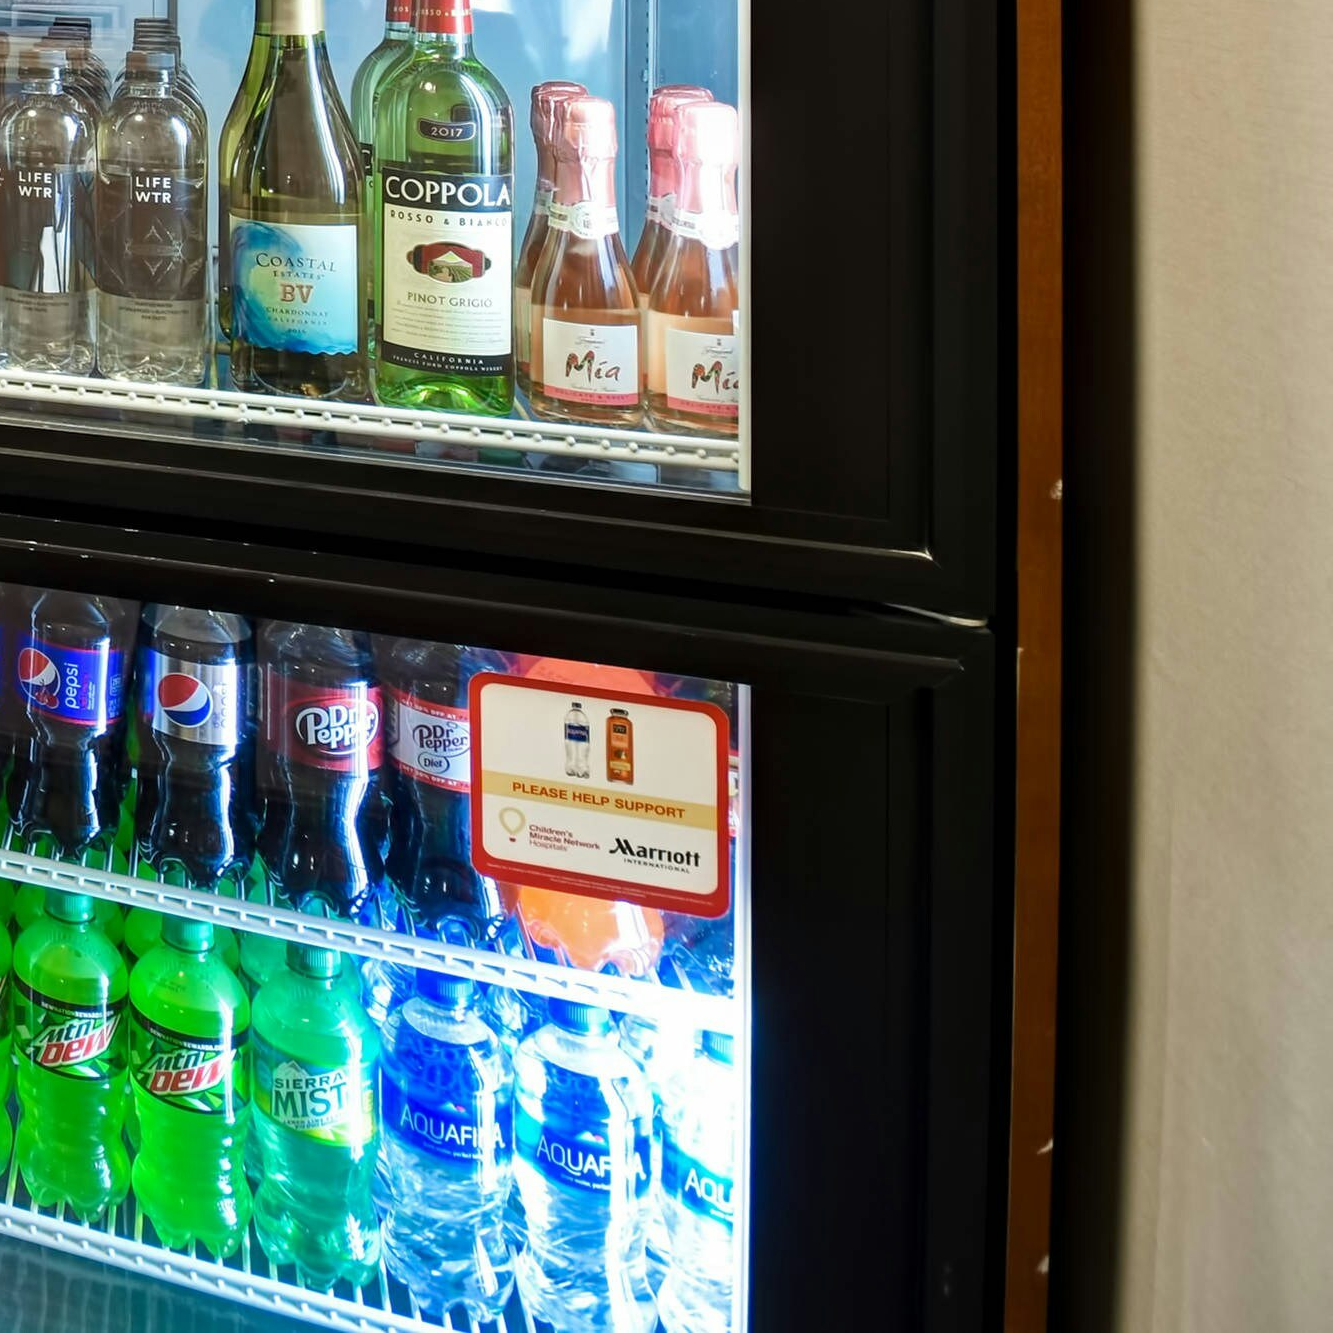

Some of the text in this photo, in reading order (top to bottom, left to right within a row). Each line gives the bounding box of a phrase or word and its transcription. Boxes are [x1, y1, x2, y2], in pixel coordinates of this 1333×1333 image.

[431, 126, 464, 137] 2017
[18, 171, 52, 184] LIFE
[135, 176, 171, 188] LIFE
[18, 185, 53, 198] WTR
[135, 190, 172, 203] WTR
[385, 176, 511, 207] COPPOLA
[390, 211, 508, 228] ROSSO & BIANCO
[255, 252, 337, 274] COASTAL
[273, 270, 322, 280] ESTATES
[279, 283, 314, 303] BV
[407, 291, 493, 308] PINOT GRIGIO
[265, 307, 329, 318] CHARDONNAY
[413, 351, 485, 365] CALIFORNIA
[65, 662, 79, 710] pepsi
[414, 724, 468, 752] Pepper
[433, 725, 453, 738] Dr
[424, 757, 443, 767] Diet
[512, 782, 685, 819] PLEASE HELP SUPPORT
[529, 824, 573, 838] Children's
[529, 832, 601, 850] Miracle Network
[529, 840, 567, 852] Hospitals
[609, 838, 701, 867] Marriott
[624, 858, 690, 874] INTERNATIONAL
[275, 1072, 344, 1090] SIERRA
[275, 1083, 350, 1117] MIST
